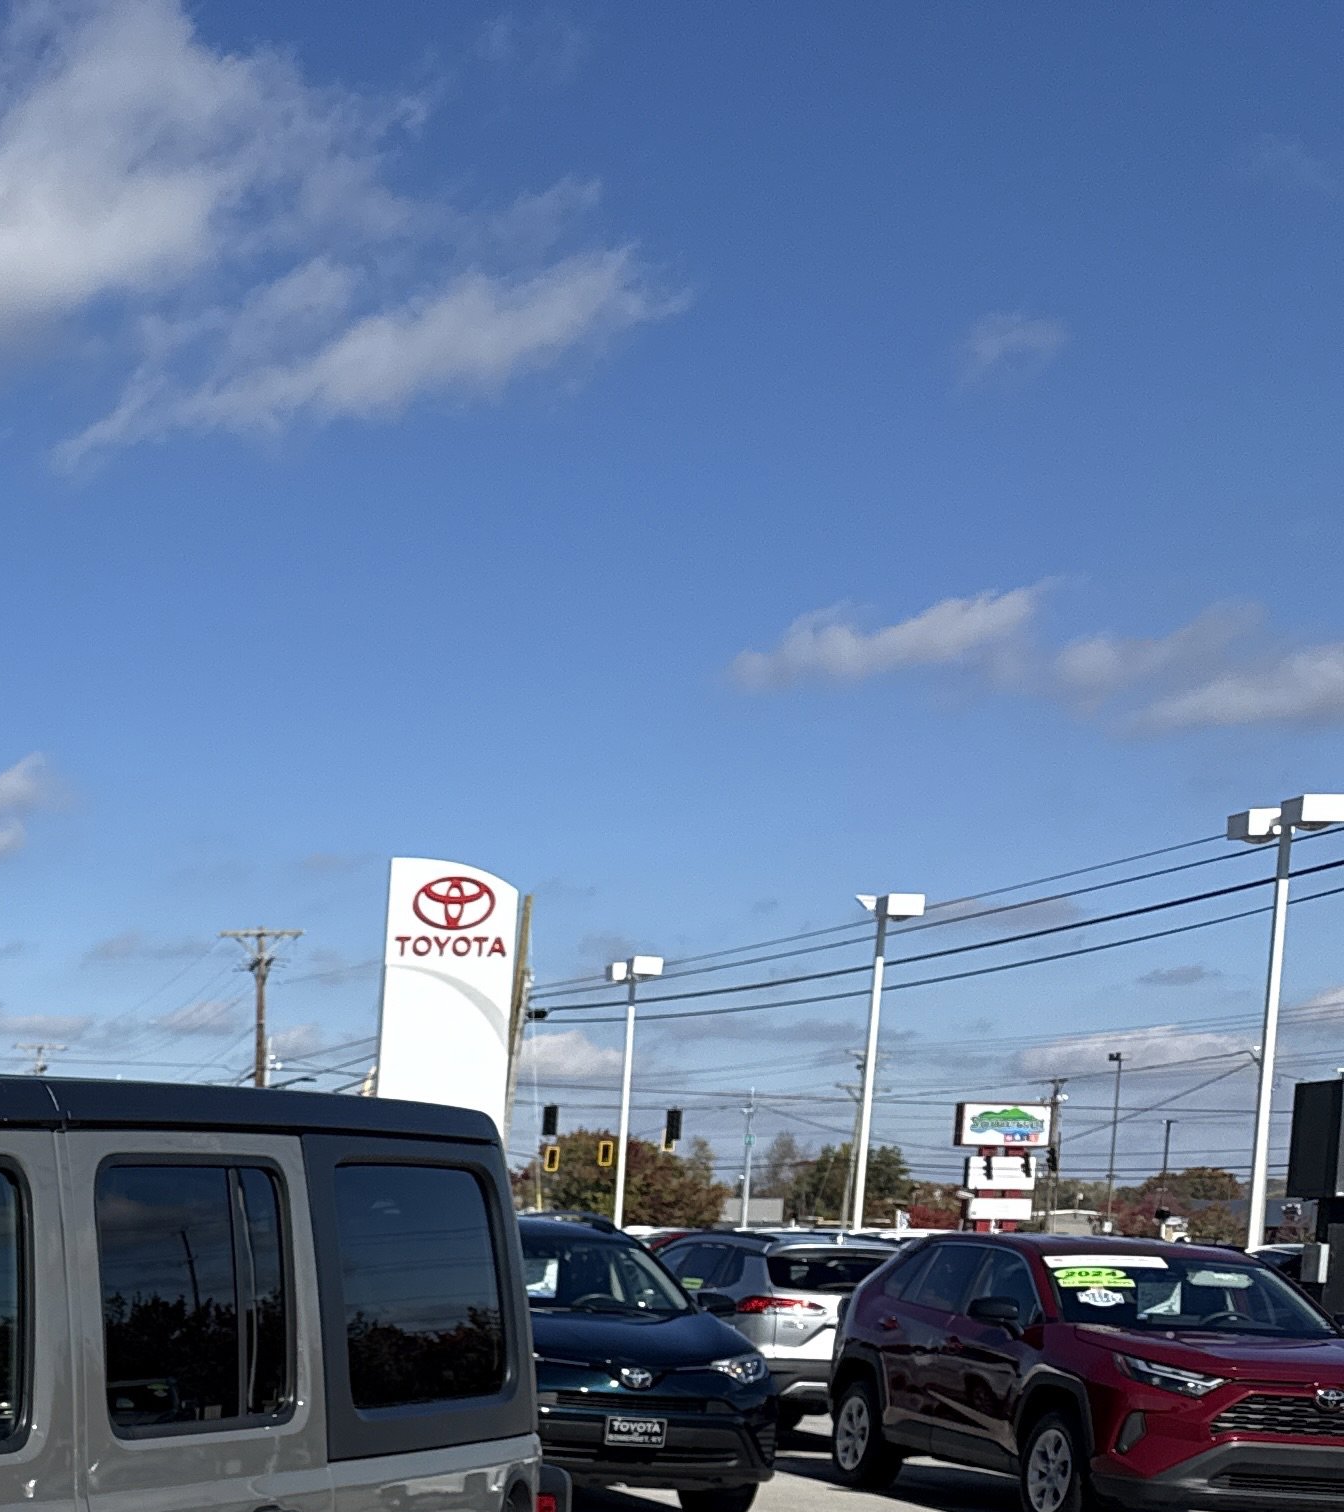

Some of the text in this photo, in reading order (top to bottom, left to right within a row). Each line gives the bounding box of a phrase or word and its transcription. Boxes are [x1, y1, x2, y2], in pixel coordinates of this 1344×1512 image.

[395, 935, 507, 957] TOYOTA
[1065, 1269, 1118, 1278] 2024
[612, 1421, 661, 1433] TOYOTA
